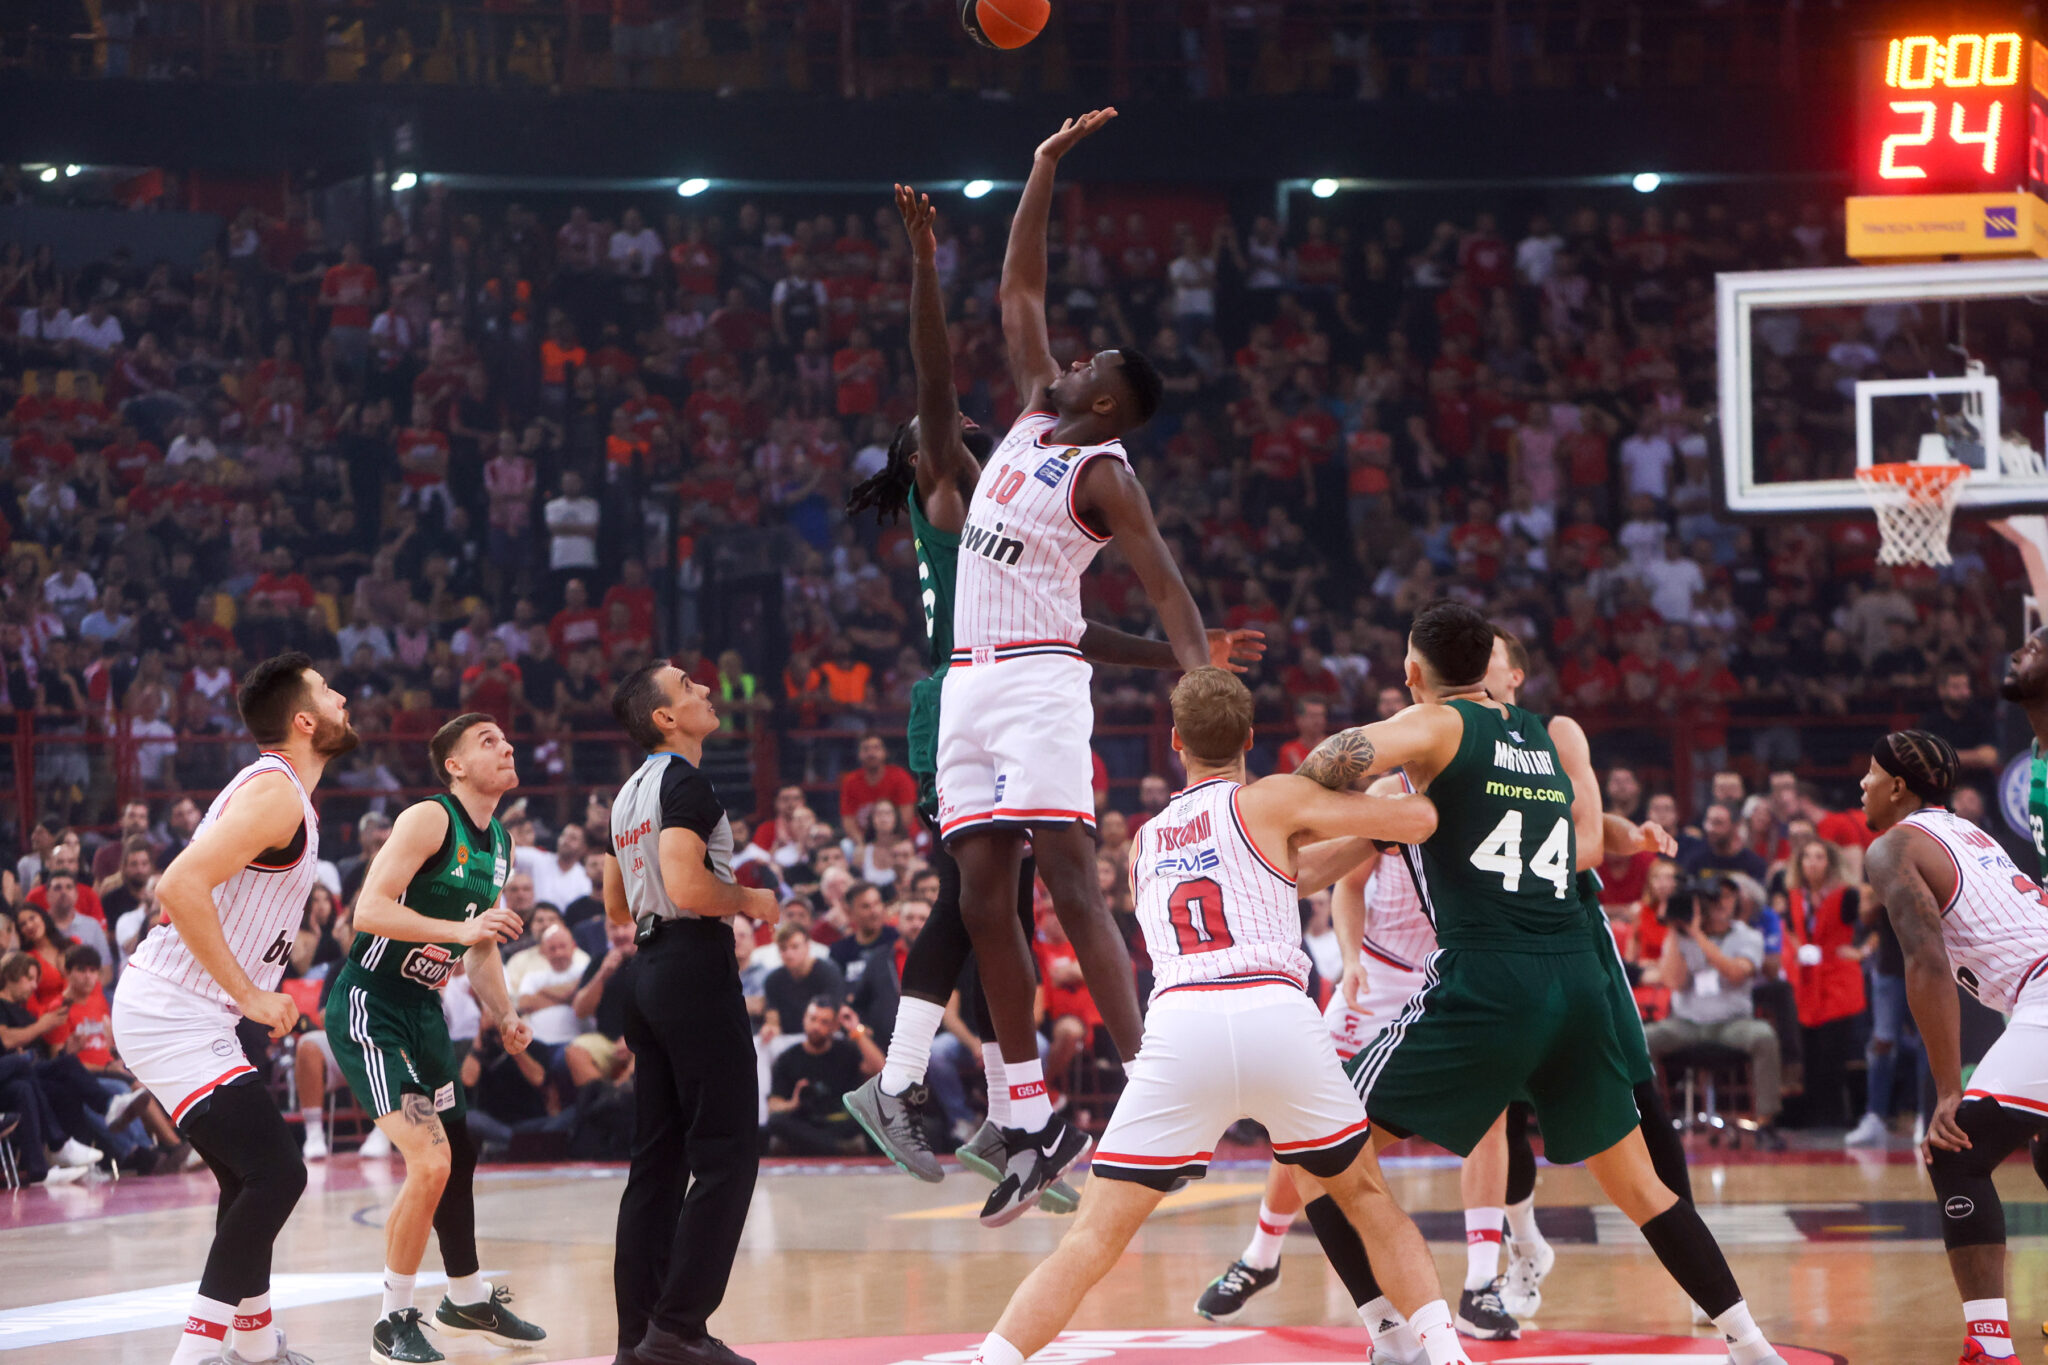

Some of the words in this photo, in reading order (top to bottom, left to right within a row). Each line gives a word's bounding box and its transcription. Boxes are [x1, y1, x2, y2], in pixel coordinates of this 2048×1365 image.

[1885, 32, 2022, 89] 10:00
[1879, 100, 2003, 179] 24
[986, 464, 1026, 505] 10
[1485, 781, 1567, 804] more.com
[1469, 809, 1569, 900] 44
[1167, 876, 1235, 956] 0
[1017, 1083, 1043, 1097] GSA
[234, 1317, 262, 1329] GSA
[1974, 1322, 2004, 1335] GSA
